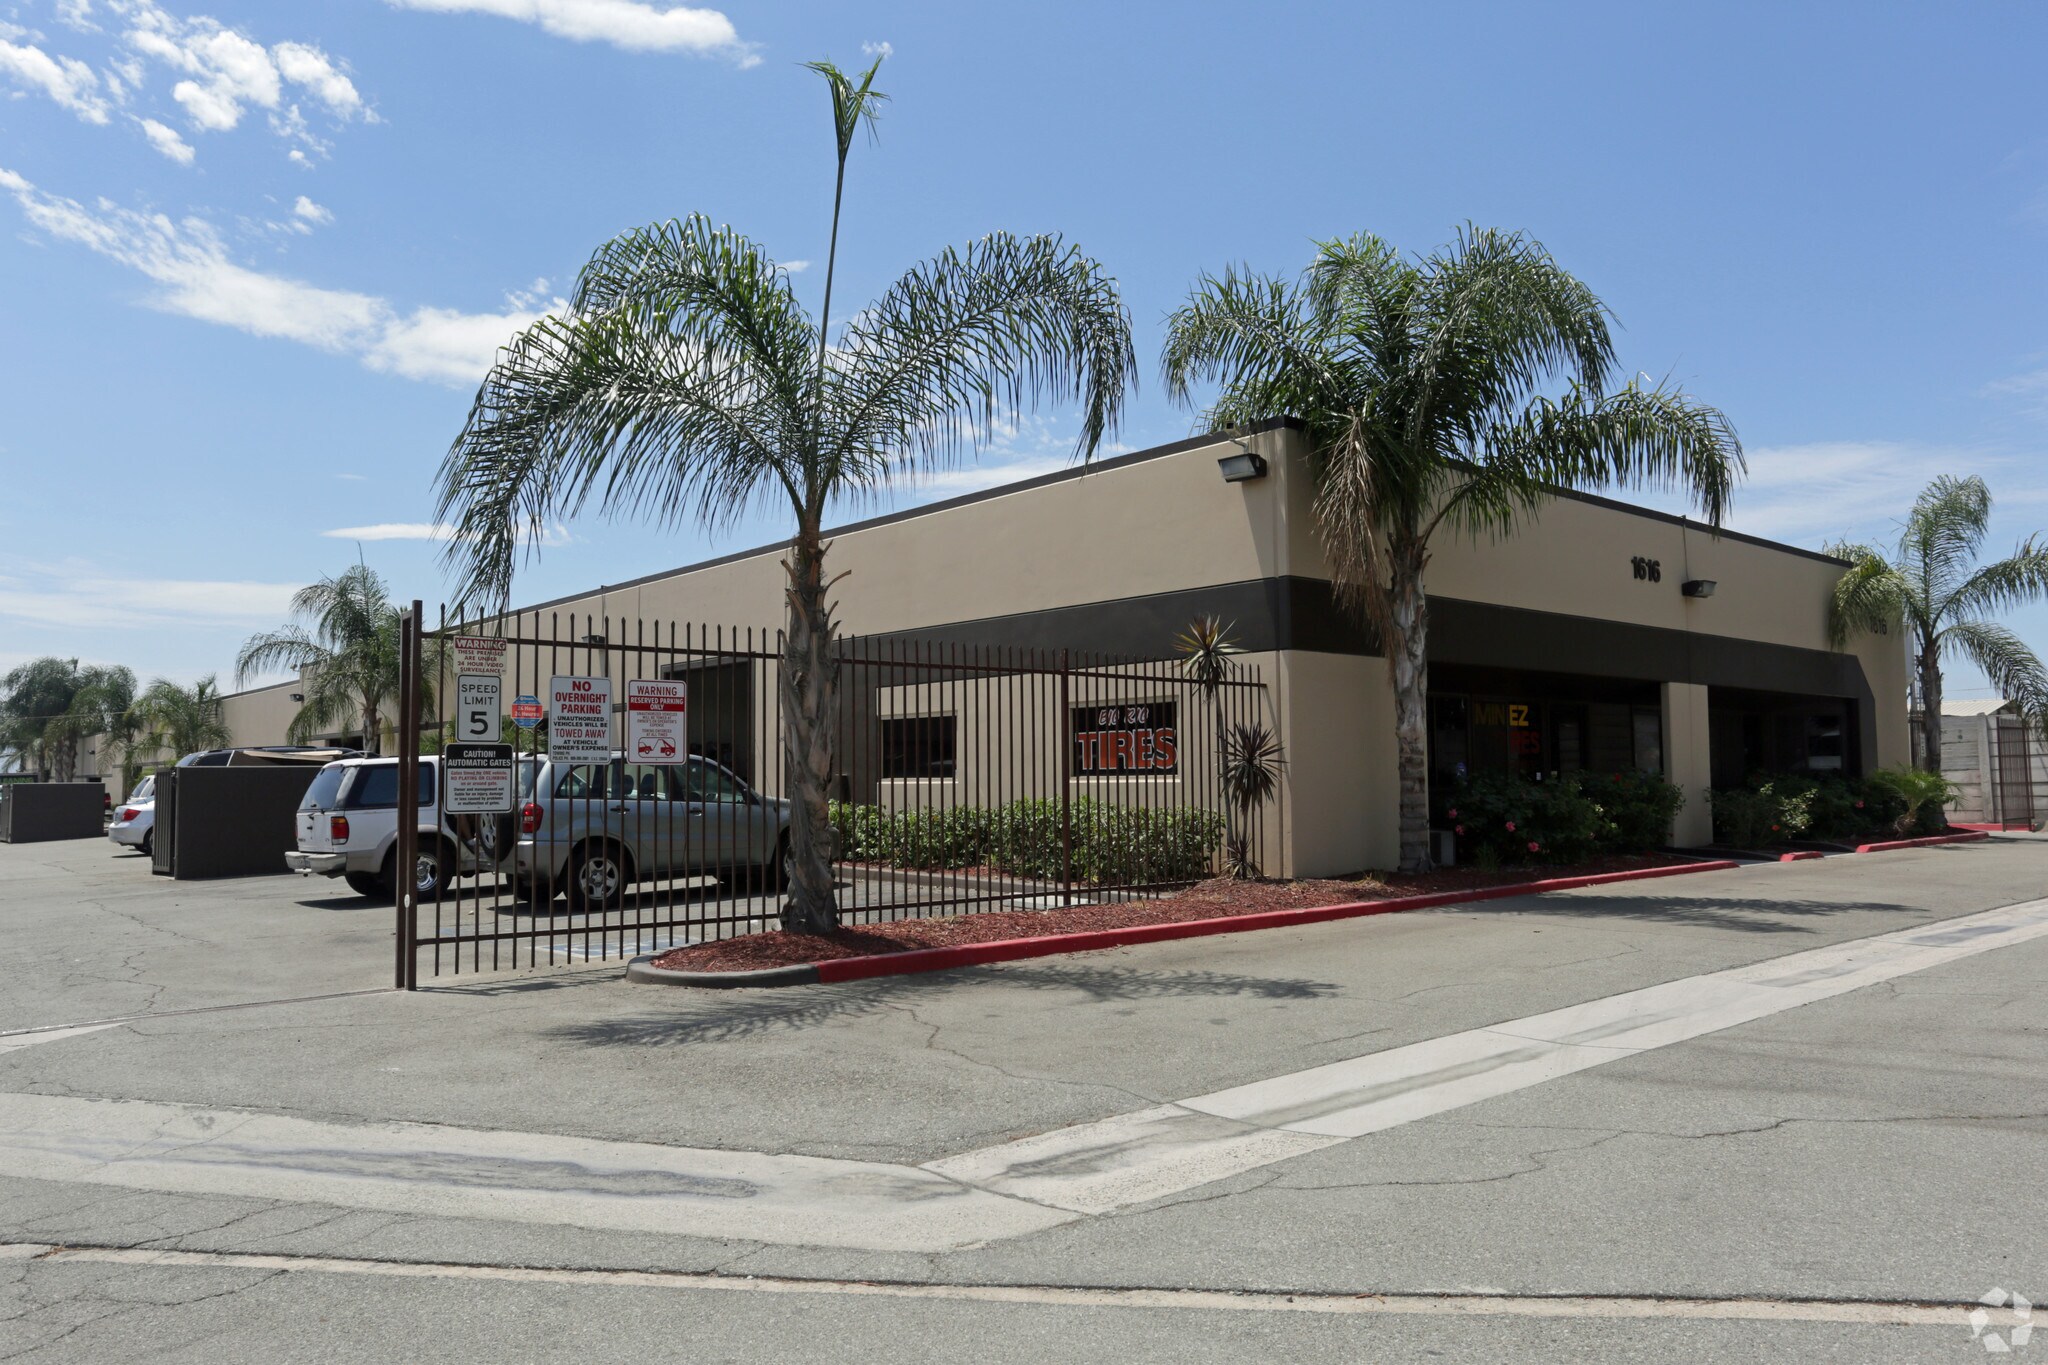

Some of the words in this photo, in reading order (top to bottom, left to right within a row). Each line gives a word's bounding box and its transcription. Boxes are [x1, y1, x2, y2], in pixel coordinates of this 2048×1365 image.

[1631, 556, 1661, 583] 1616
[456, 640, 506, 650] WARNING
[461, 684, 498, 694] SPEED
[572, 681, 591, 691] NO
[637, 686, 678, 696] WARNING
[465, 697, 494, 705] LIMIT
[555, 692, 607, 703] OVERNIGHT
[561, 704, 601, 714] PARKING
[1099, 709, 1119, 726] BIG
[1124, 707, 1149, 724] RIG
[470, 711, 488, 735] 5
[555, 729, 582, 738] TOWED
[585, 729, 606, 738] AWAY
[1075, 728, 1178, 770] TIRES
